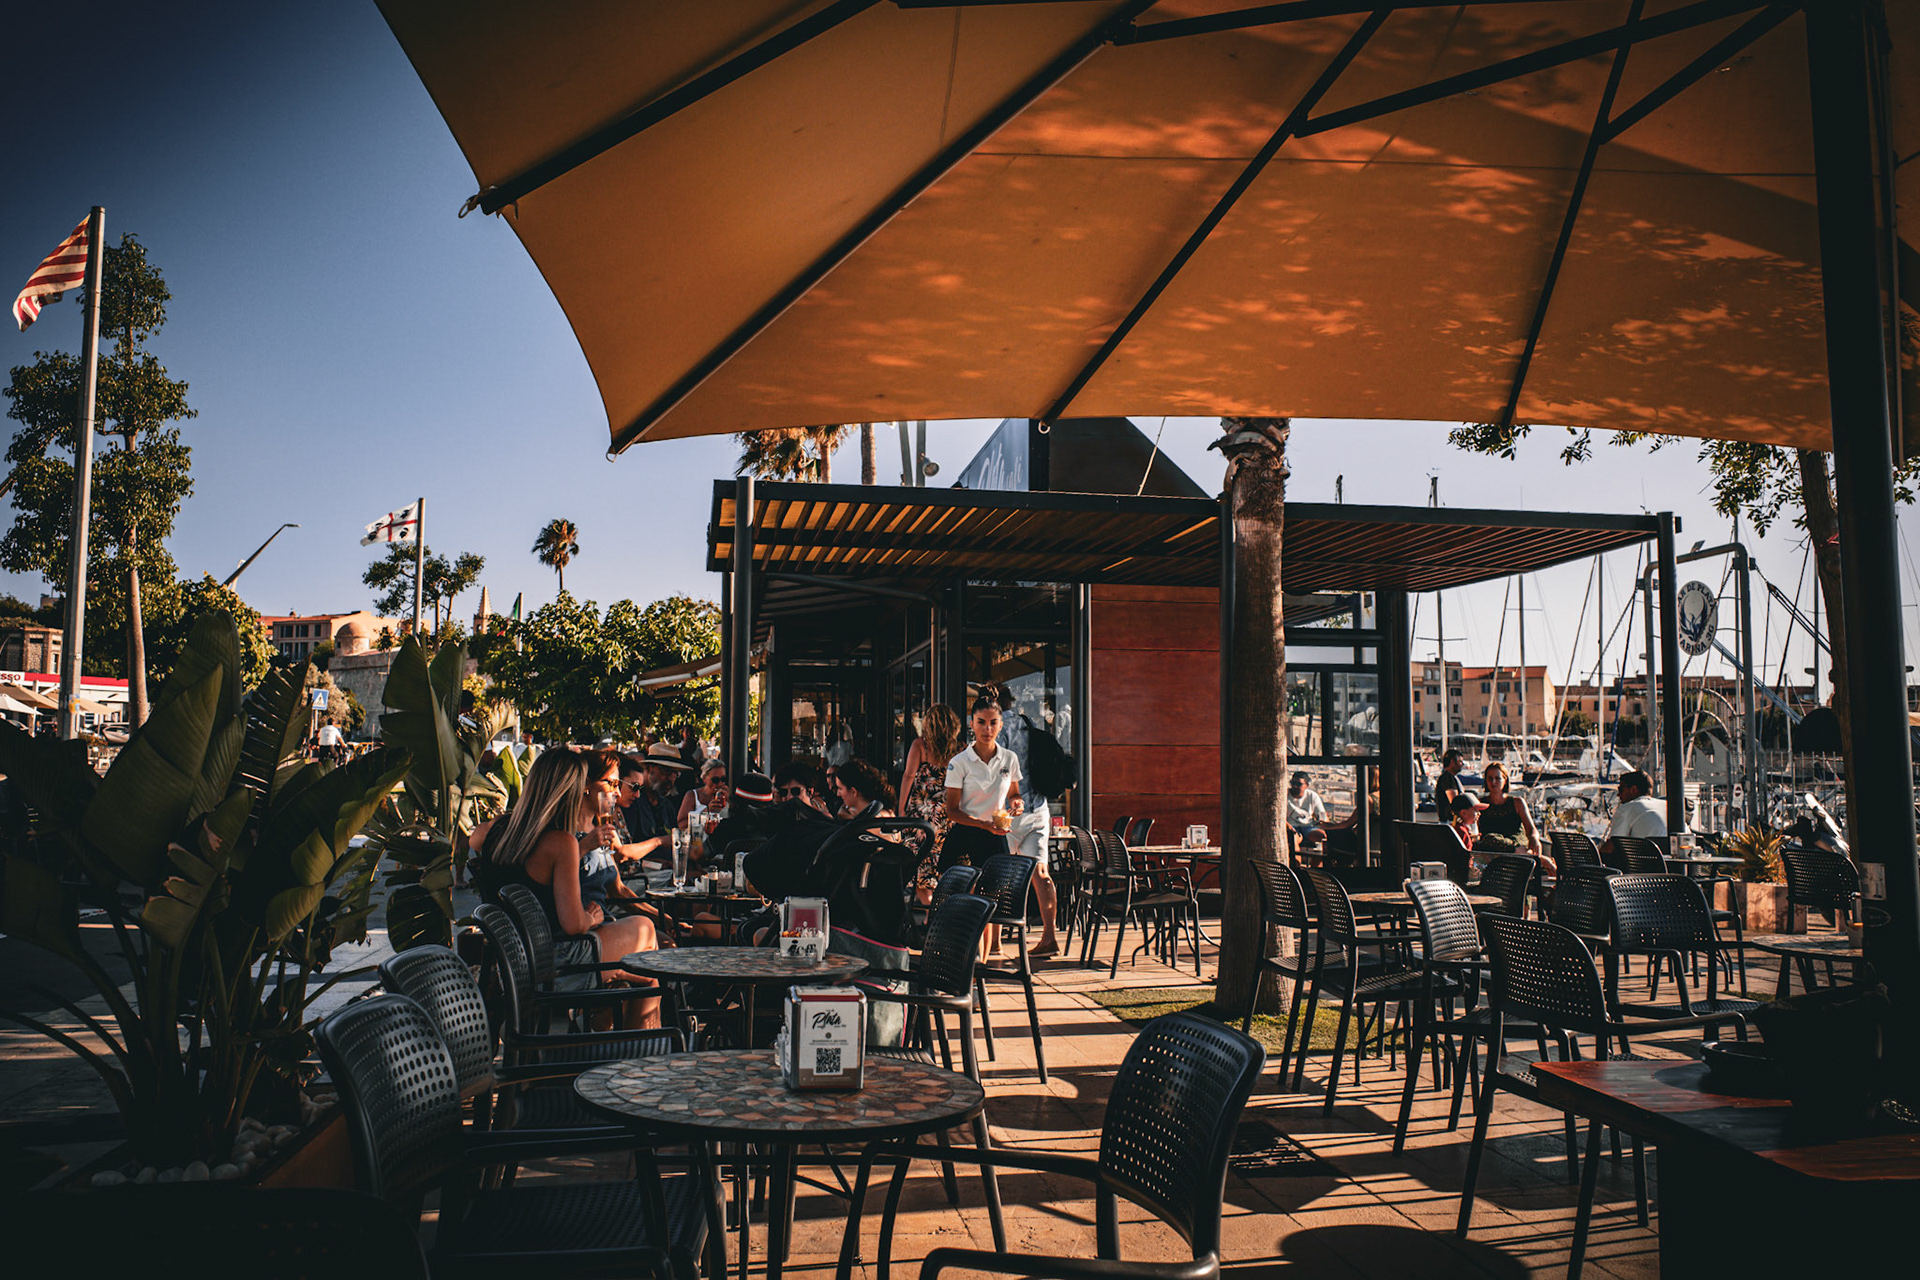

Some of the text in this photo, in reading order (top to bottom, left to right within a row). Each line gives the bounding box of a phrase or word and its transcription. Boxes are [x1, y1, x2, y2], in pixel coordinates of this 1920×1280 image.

[1687, 583, 1696, 592] DE
[1679, 635, 1706, 653] ARINA
[0, 673, 21, 681] SSO
